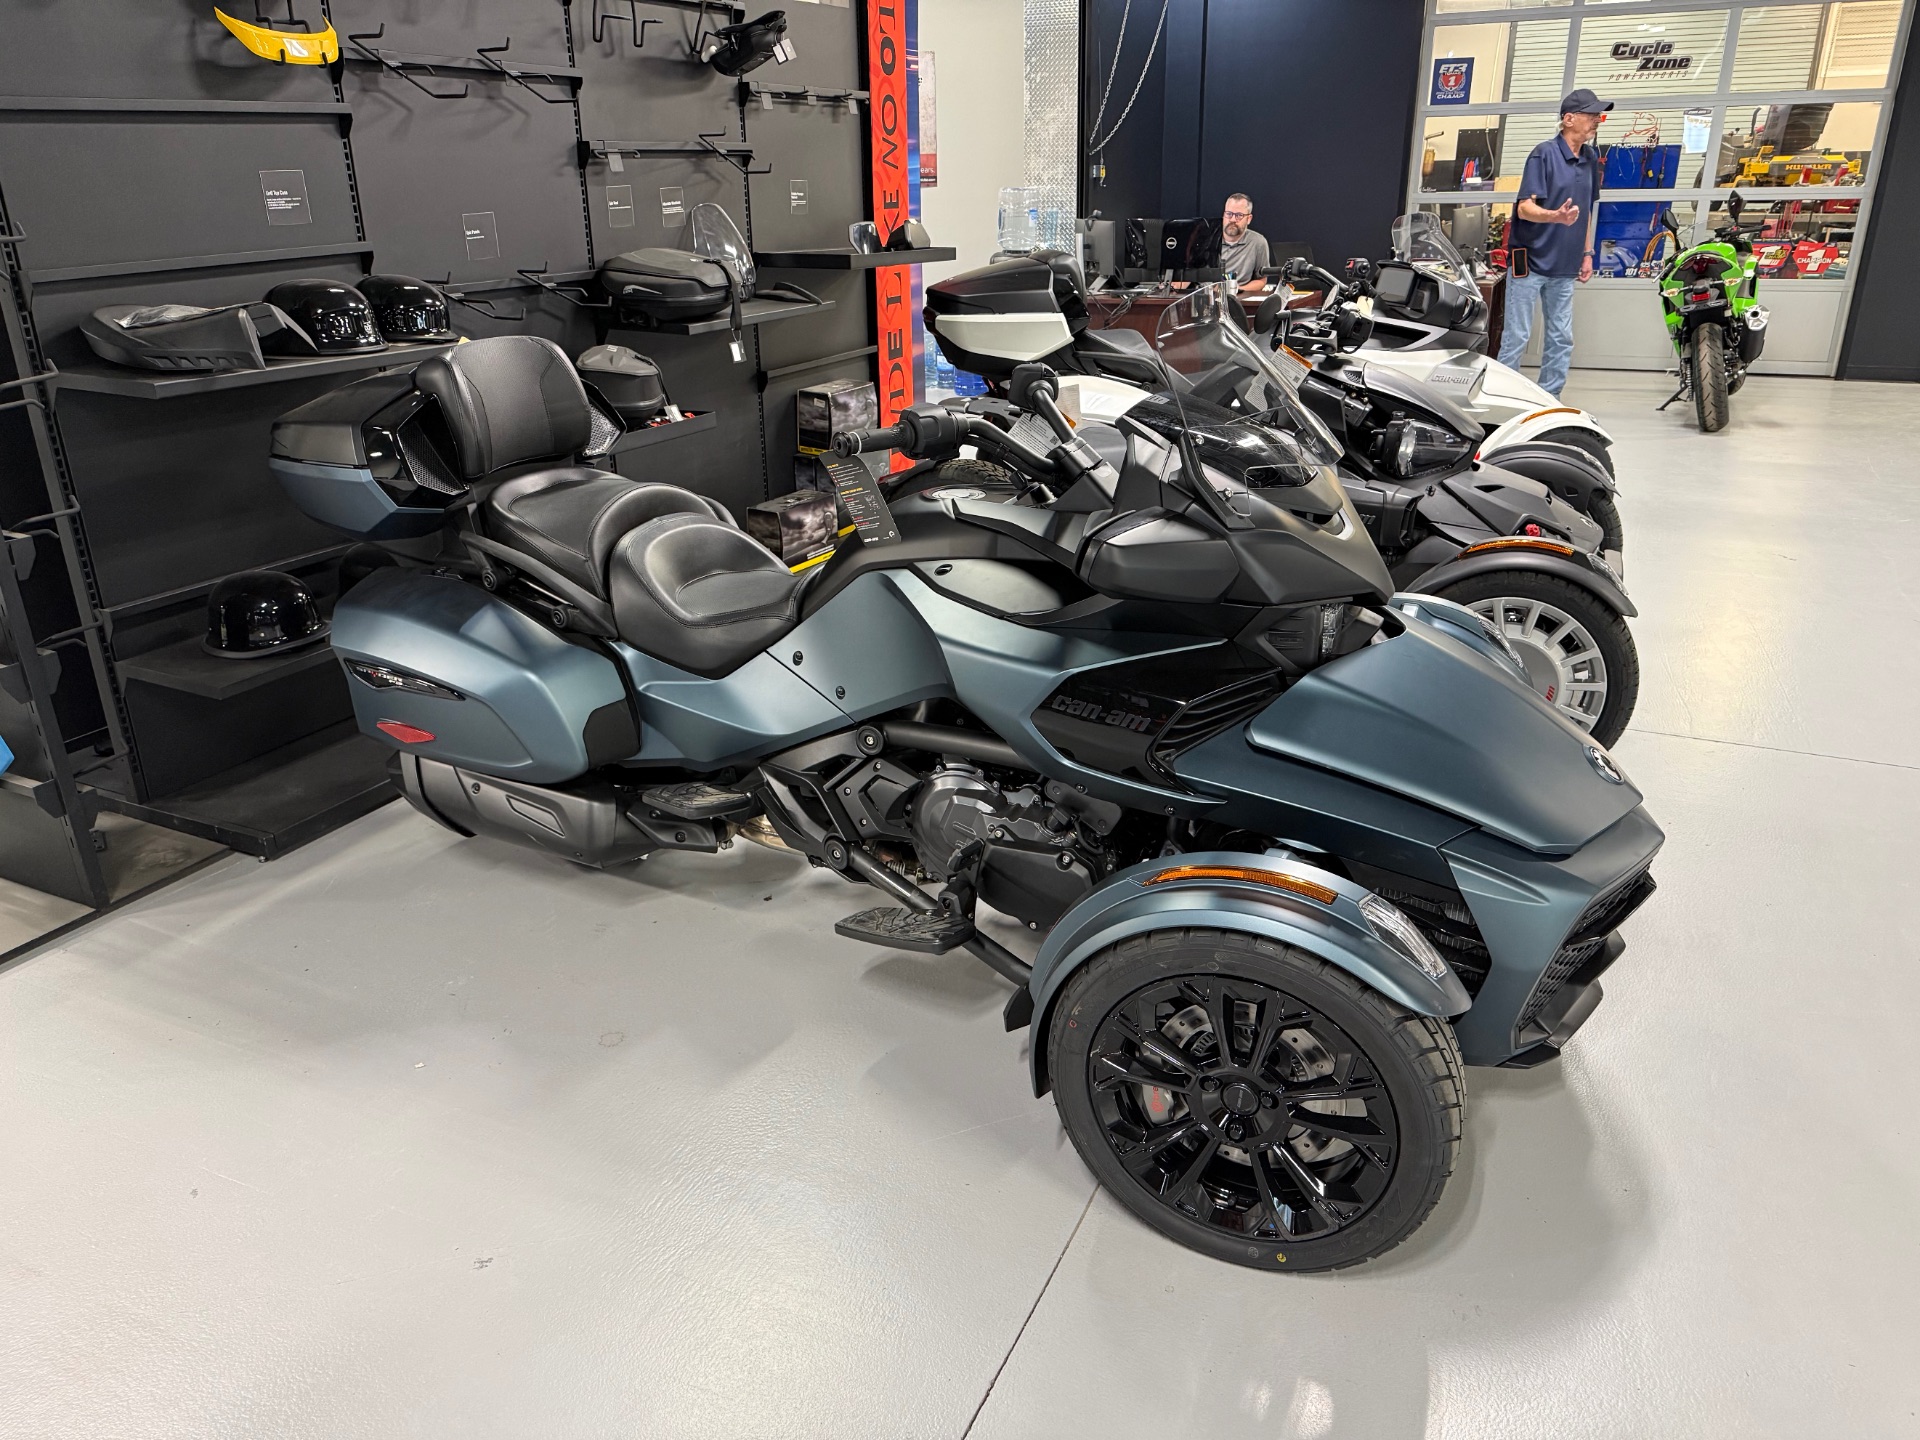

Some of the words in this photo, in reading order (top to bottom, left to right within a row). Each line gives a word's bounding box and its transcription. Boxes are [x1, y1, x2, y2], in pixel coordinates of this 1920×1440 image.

[878, 0, 896, 76] OT
[1610, 40, 1675, 59] Cycle
[1608, 70, 1689, 81] POWERSPORTS
[1636, 56, 1693, 72] Zone
[1447, 75, 1457, 86] 1
[881, 94, 899, 170] NO
[883, 189, 903, 313] LKE
[1051, 694, 1151, 732] can-am
